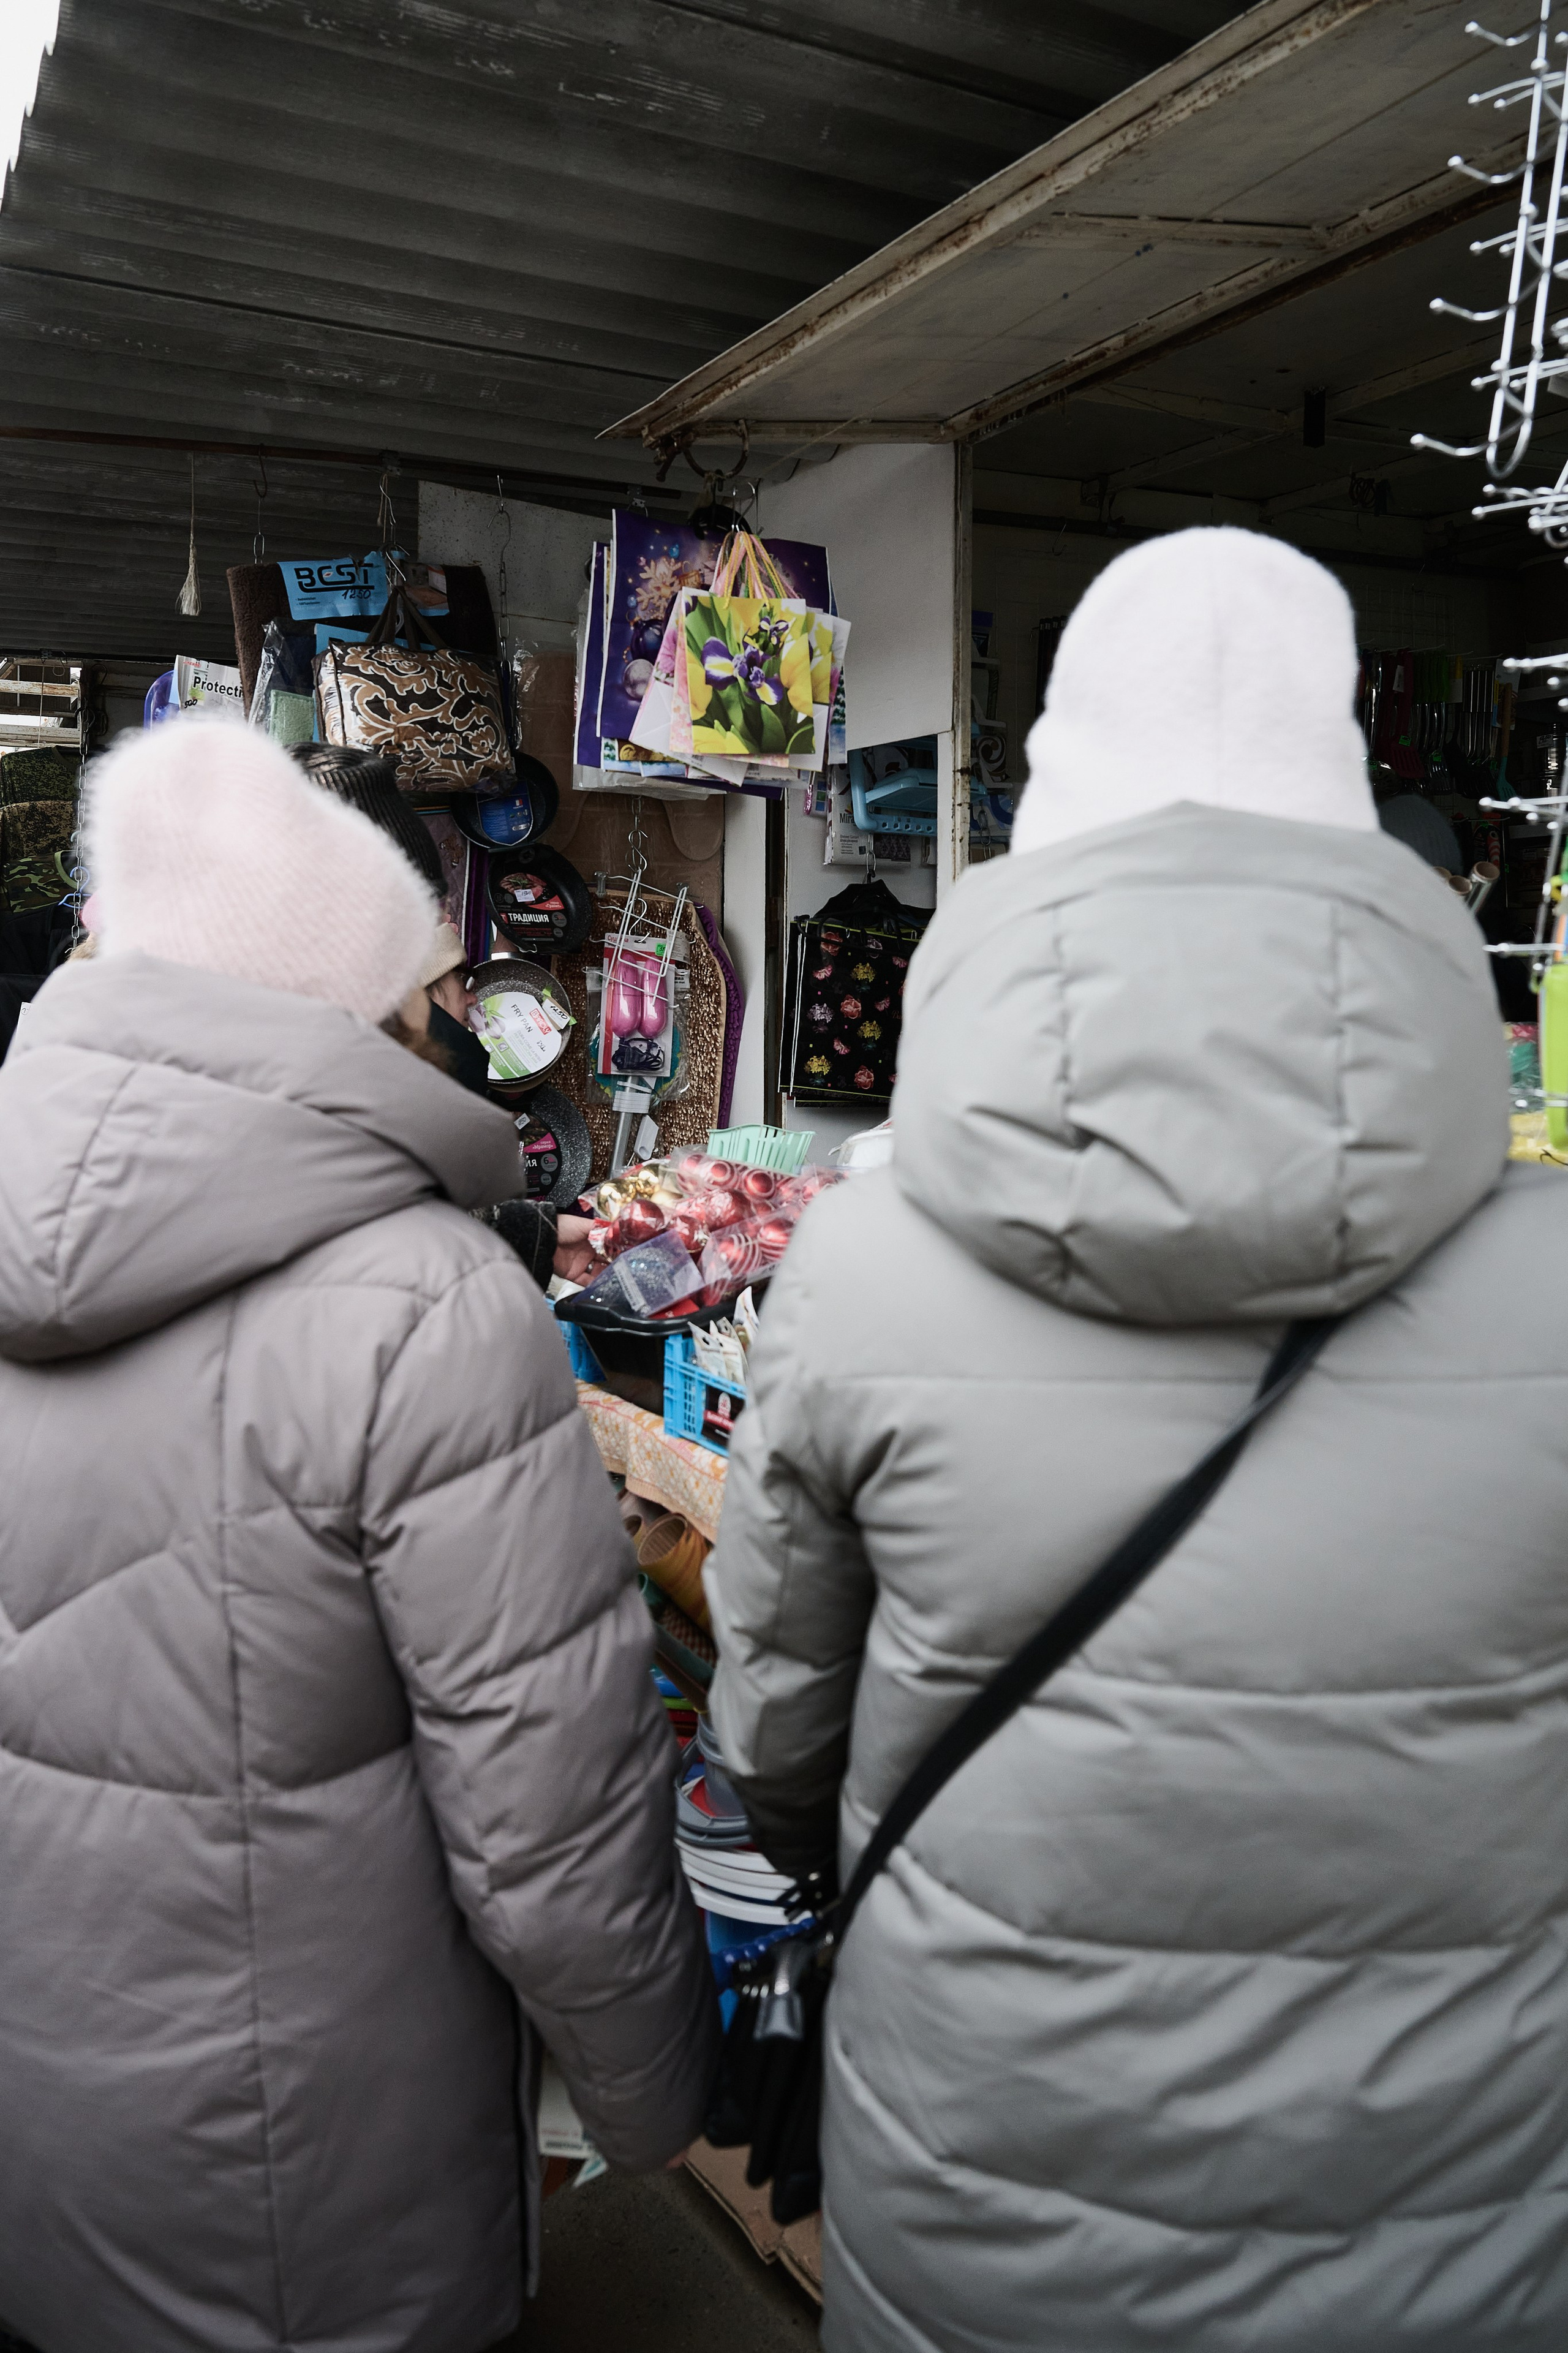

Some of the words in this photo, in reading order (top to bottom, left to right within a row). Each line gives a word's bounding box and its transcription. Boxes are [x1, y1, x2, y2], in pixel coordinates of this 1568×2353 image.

[341, 589, 372, 600] 1250
[193, 676, 244, 698] Protecti
[184, 698, 198, 709] 500
[508, 913, 549, 923] ТРАДИЦИЯ
[511, 1004, 524, 1018] FRY
[521, 1018, 533, 1032] PAN
[551, 1005, 568, 1020] 1250
